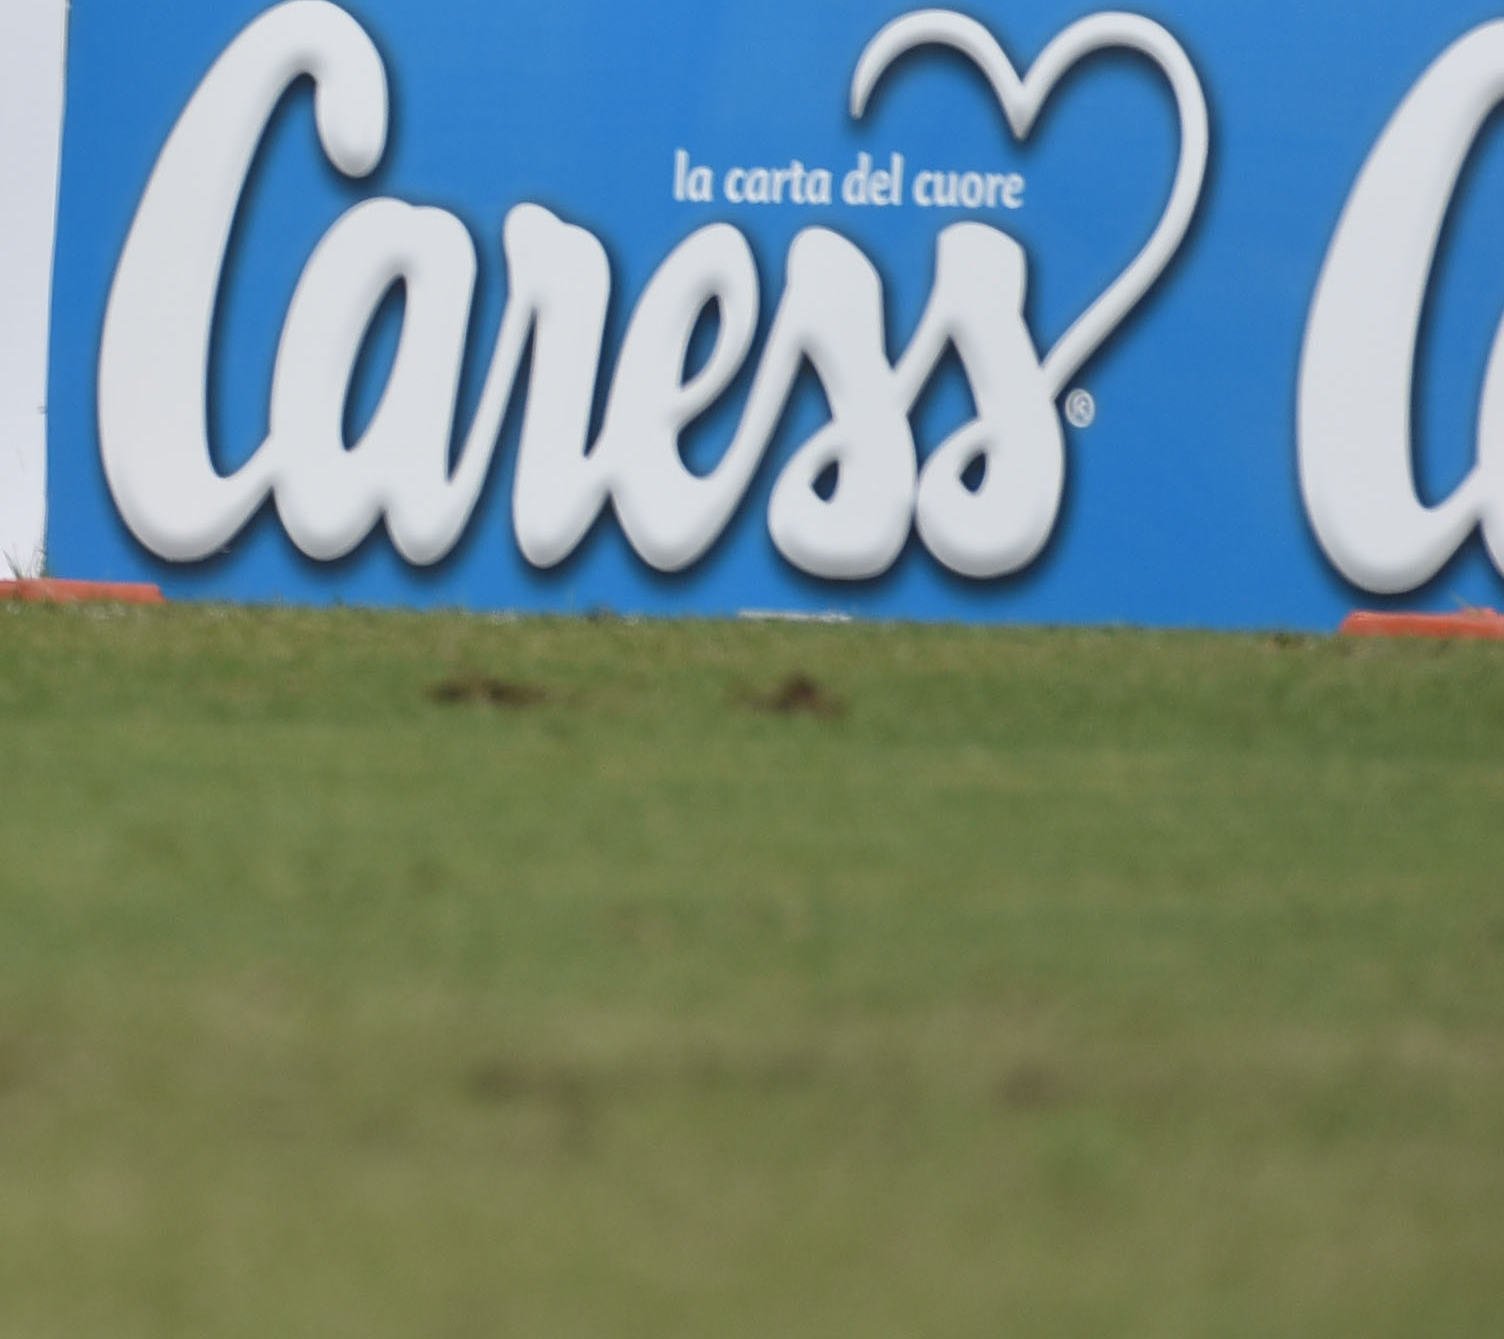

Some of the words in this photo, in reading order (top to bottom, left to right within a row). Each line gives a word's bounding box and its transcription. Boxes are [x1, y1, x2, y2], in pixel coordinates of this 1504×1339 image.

[675, 150, 717, 203] la
[723, 161, 832, 203] carta
[841, 151, 904, 206] del
[912, 165, 1026, 210] cuore
